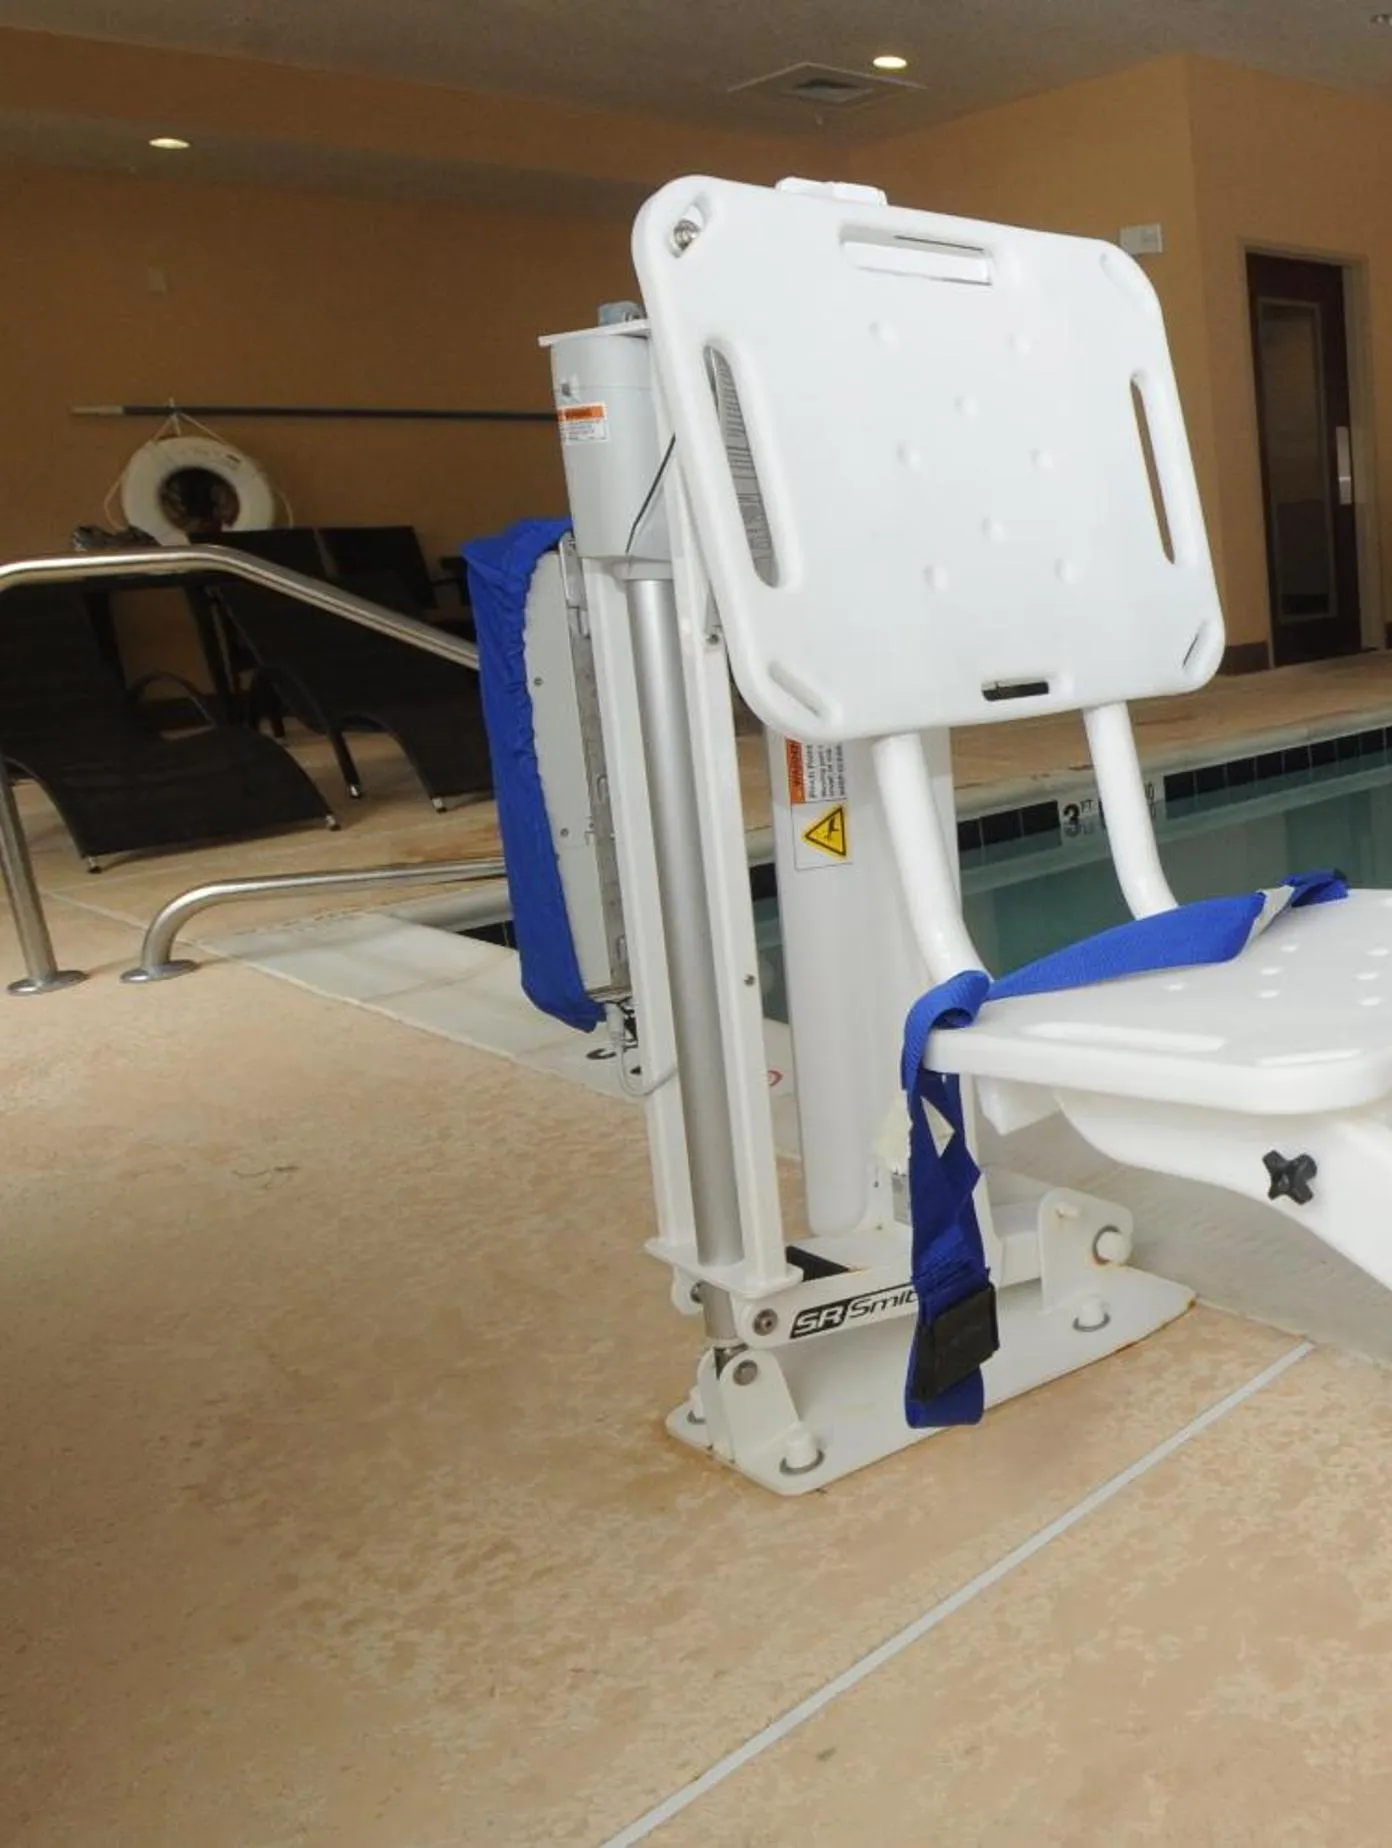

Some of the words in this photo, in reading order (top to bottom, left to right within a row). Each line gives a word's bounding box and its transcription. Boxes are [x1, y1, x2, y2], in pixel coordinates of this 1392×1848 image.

[1063, 804, 1080, 836] 3
[794, 1304, 845, 1335] SR
[850, 1291, 919, 1319] Smit
